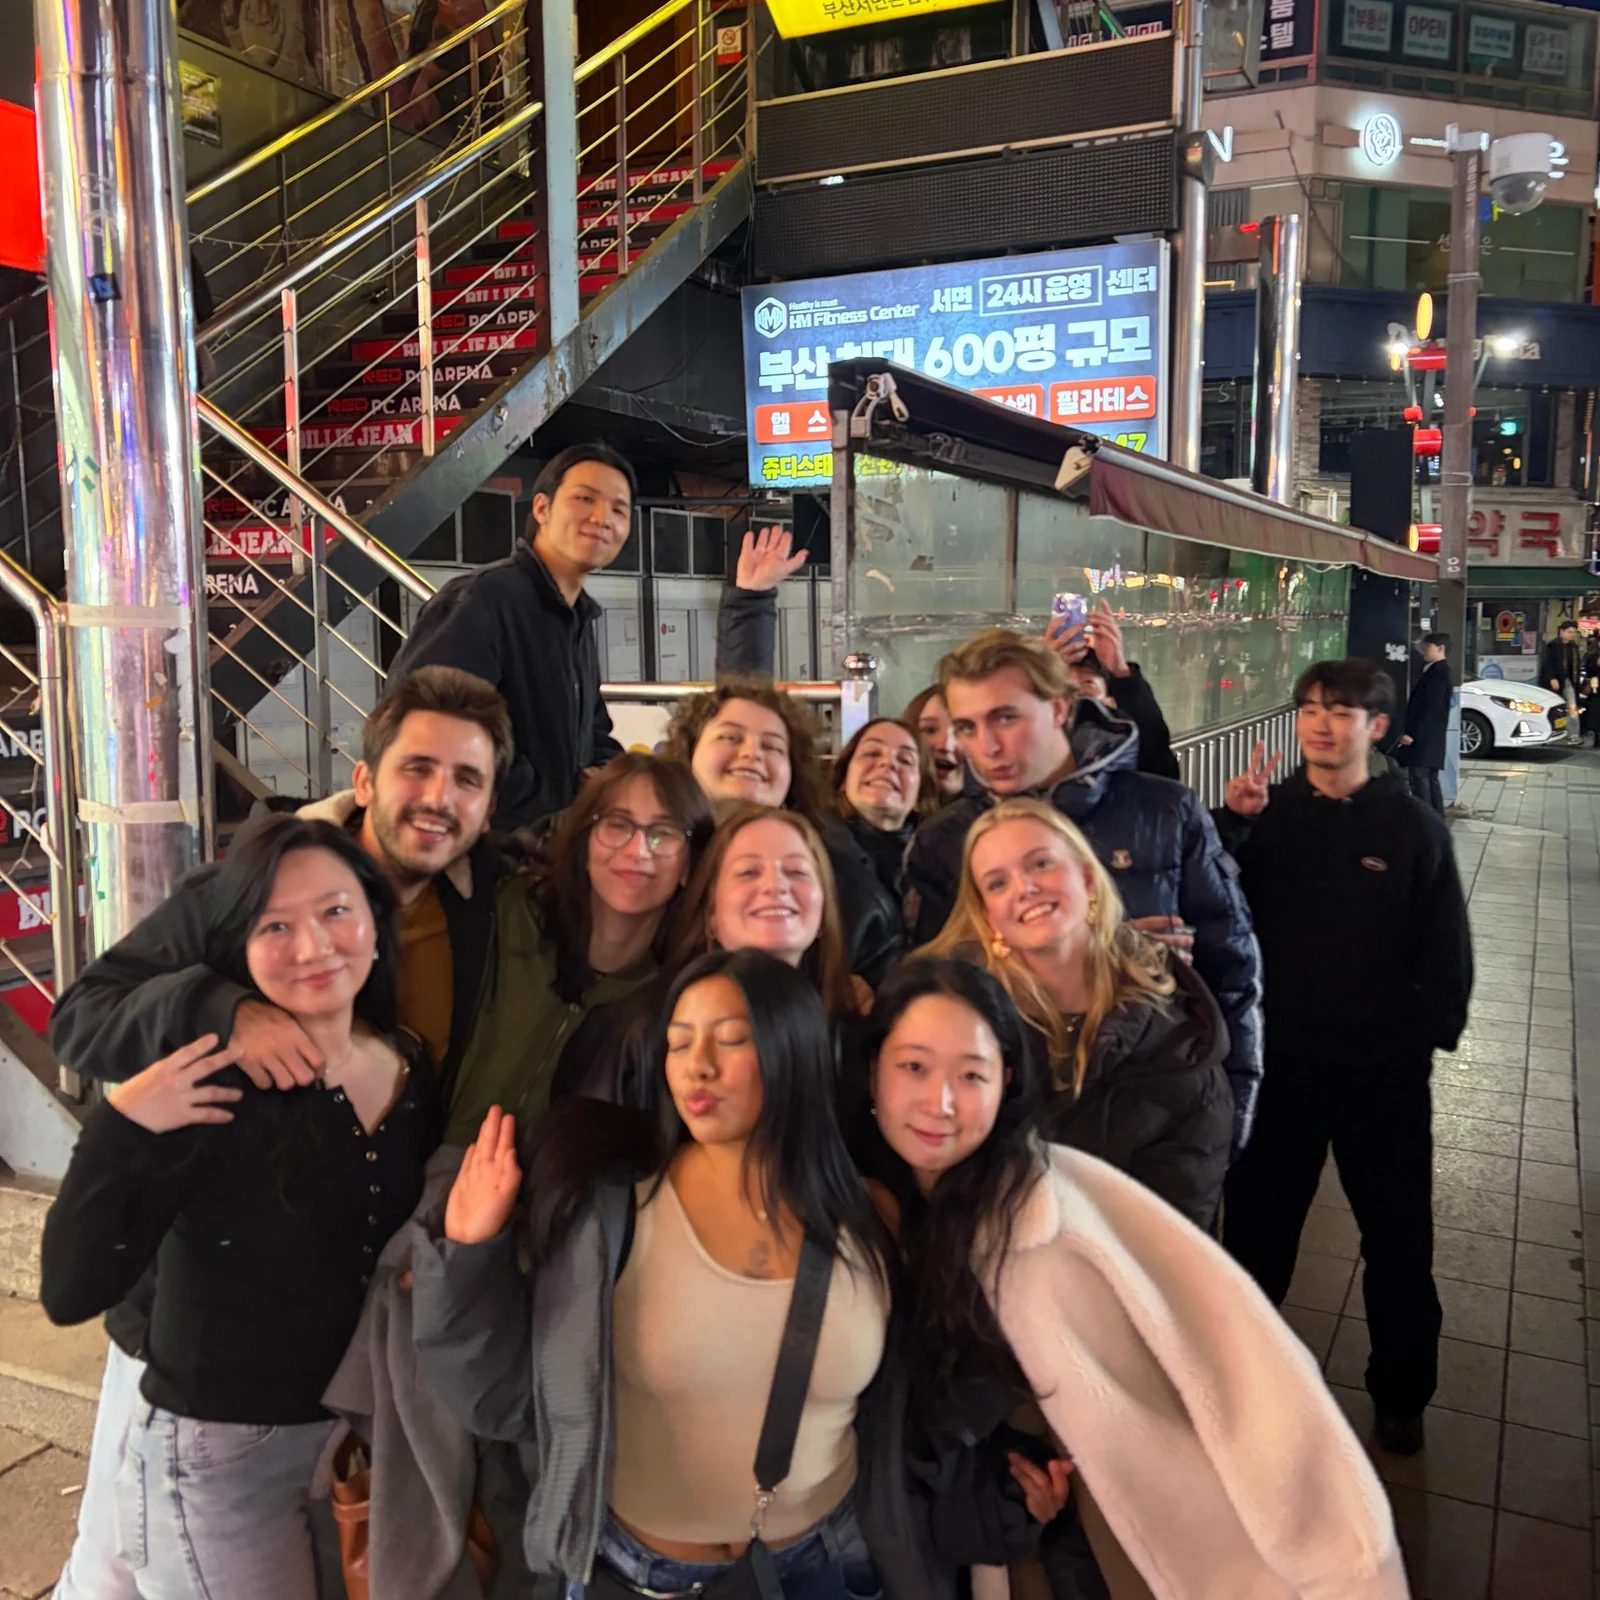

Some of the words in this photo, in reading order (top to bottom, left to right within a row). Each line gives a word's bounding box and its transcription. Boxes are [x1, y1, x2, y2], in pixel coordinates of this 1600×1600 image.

[1408, 15, 1449, 40] OPEN
[929, 285, 973, 314] 서면
[986, 277, 1043, 308] 24시
[1045, 272, 1092, 304] 운영
[1105, 265, 1157, 297] 센터
[814, 308, 868, 328] Fitness
[869, 304, 921, 321] Center
[923, 323, 1057, 379] 600평
[1065, 316, 1152, 368] 규모
[1056, 385, 1150, 416] 필라테스
[357, 422, 415, 446] JEAN
[762, 453, 834, 480] 쥬디스태
[204, 573, 260, 595] RENA
